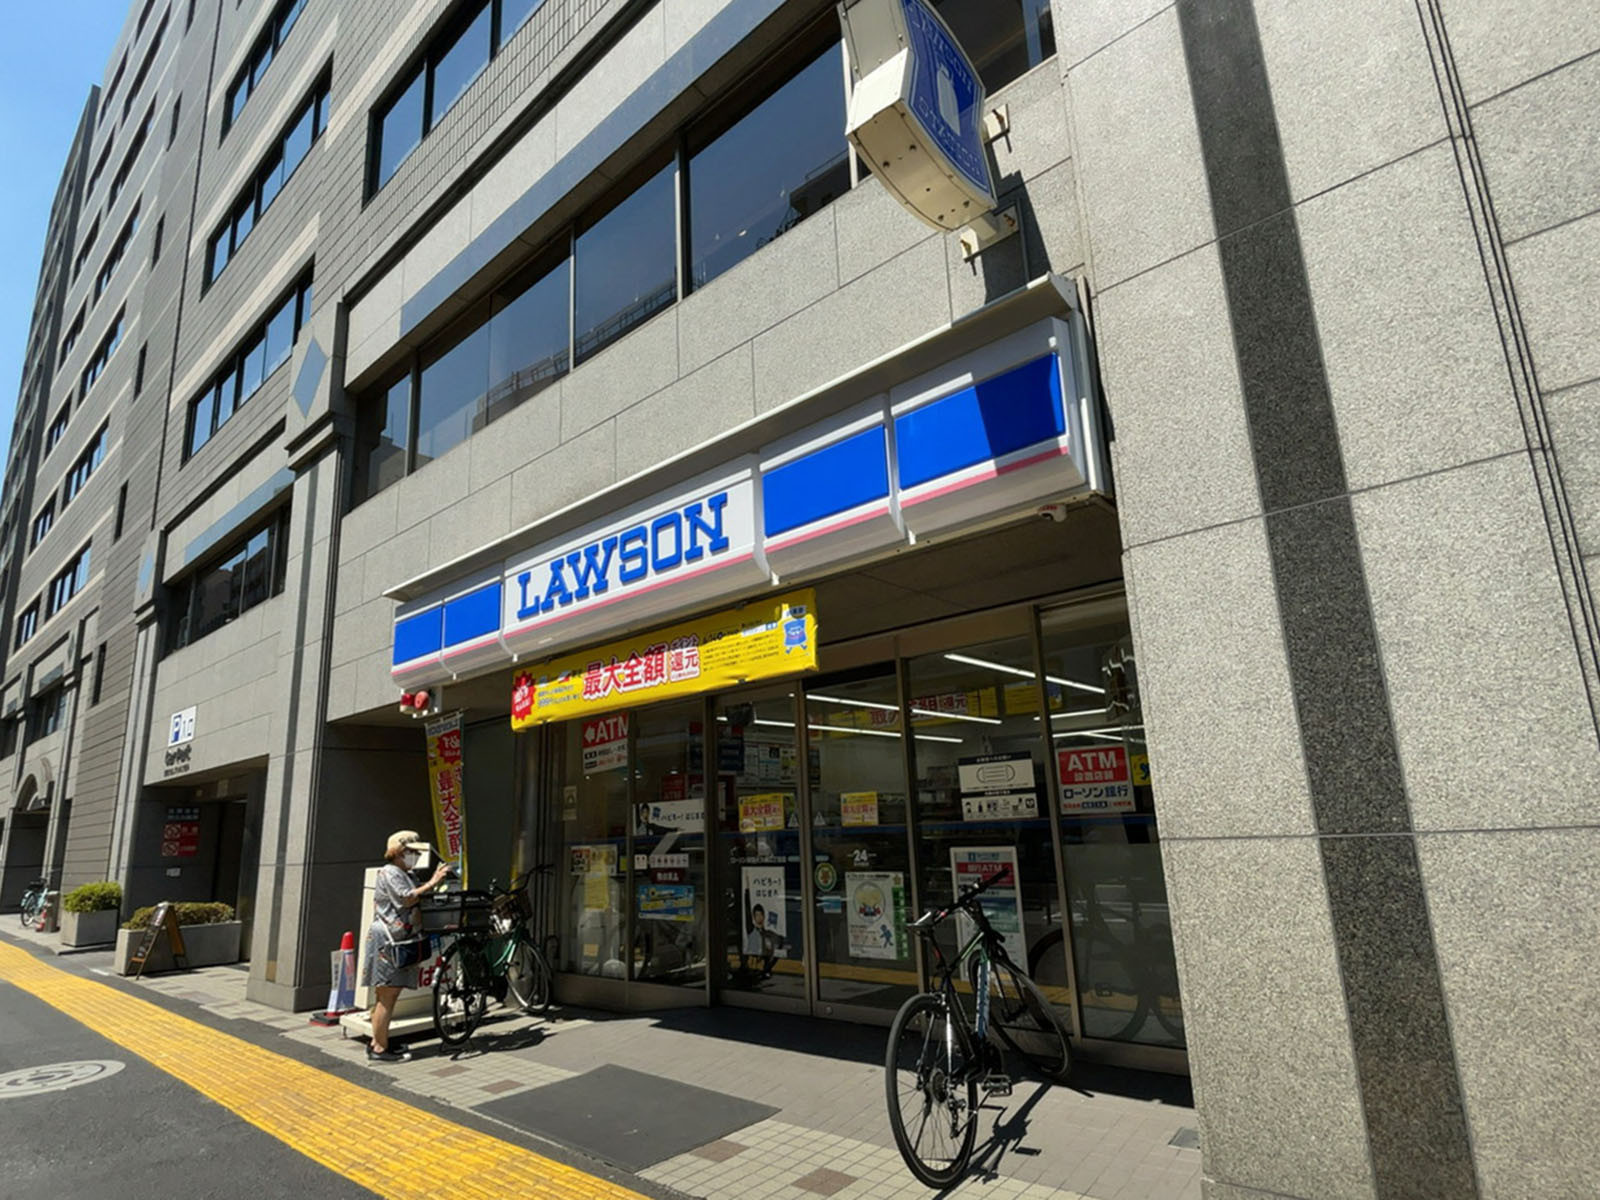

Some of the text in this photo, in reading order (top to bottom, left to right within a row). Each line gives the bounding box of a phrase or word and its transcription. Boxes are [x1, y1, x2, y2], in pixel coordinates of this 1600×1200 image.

[517, 492, 728, 619] LAWSON
[583, 645, 667, 697] 最大全額
[670, 650, 698, 672] 還元
[1068, 751, 1117, 771] ATM
[1063, 785, 1128, 799] ローソン銀行
[853, 849, 868, 862] 24
